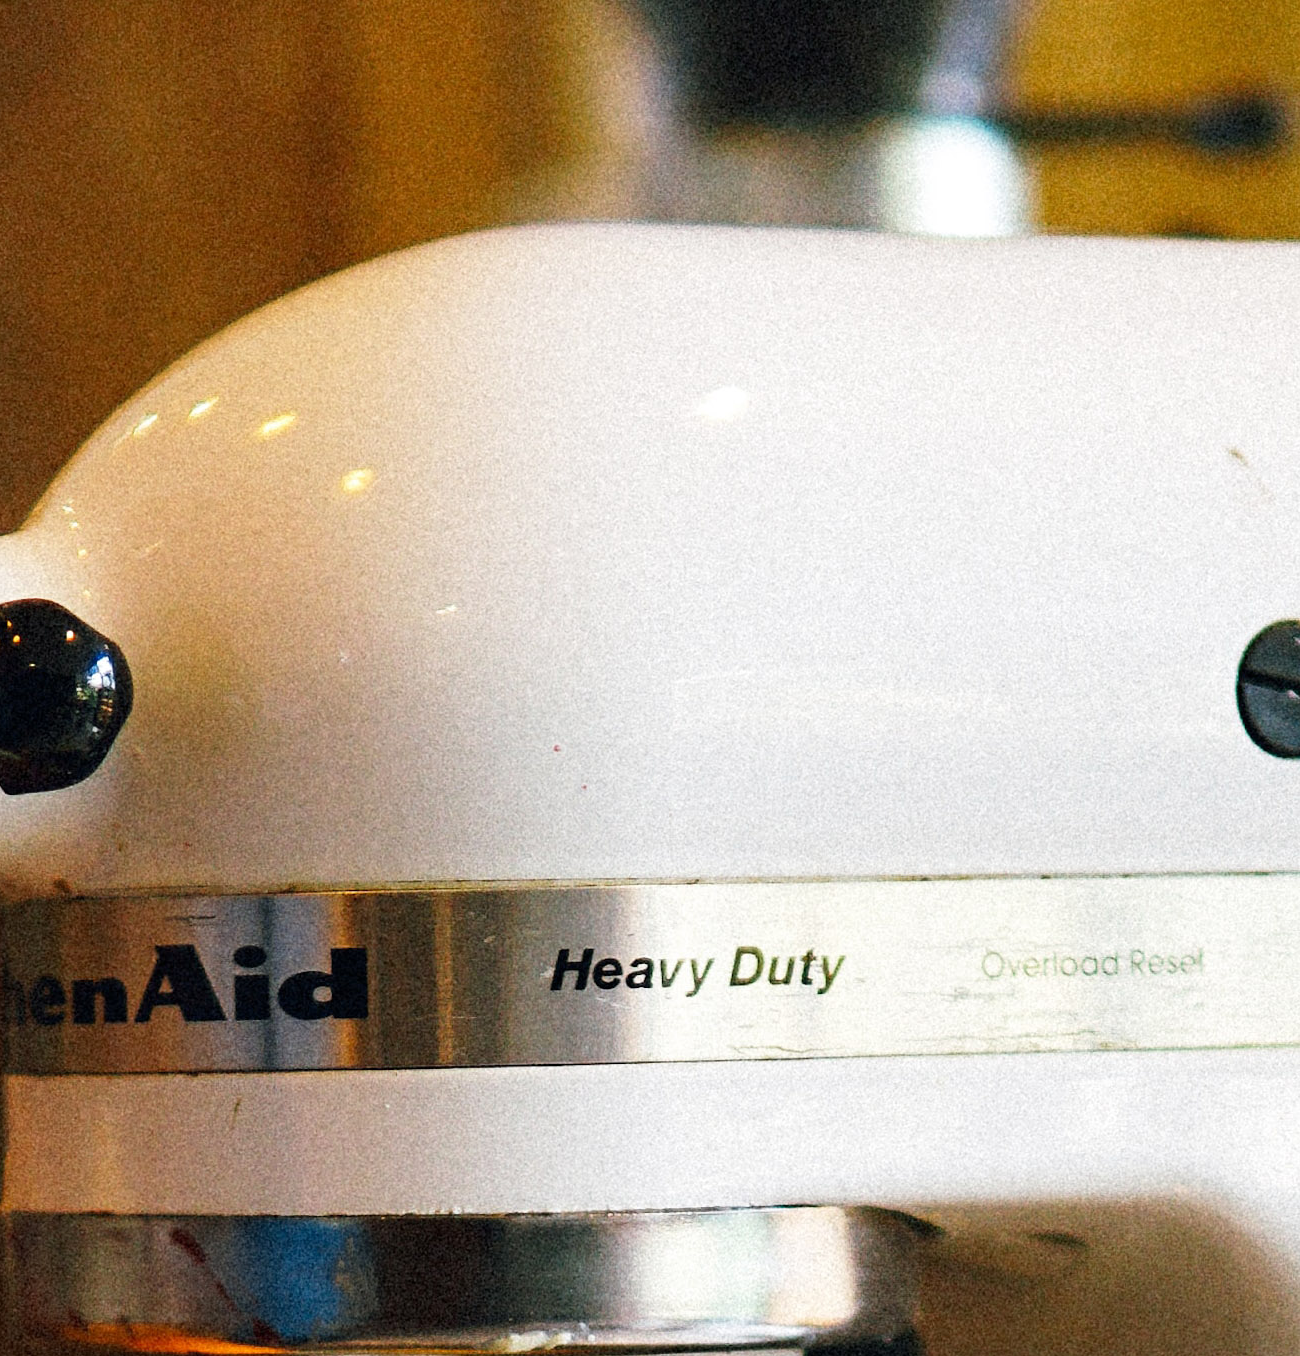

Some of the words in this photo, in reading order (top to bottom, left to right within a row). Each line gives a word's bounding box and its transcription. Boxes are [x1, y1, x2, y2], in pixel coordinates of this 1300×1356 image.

[551, 948, 715, 997] Heavy
[729, 945, 846, 995] Duty
[981, 951, 1119, 979] Overload
